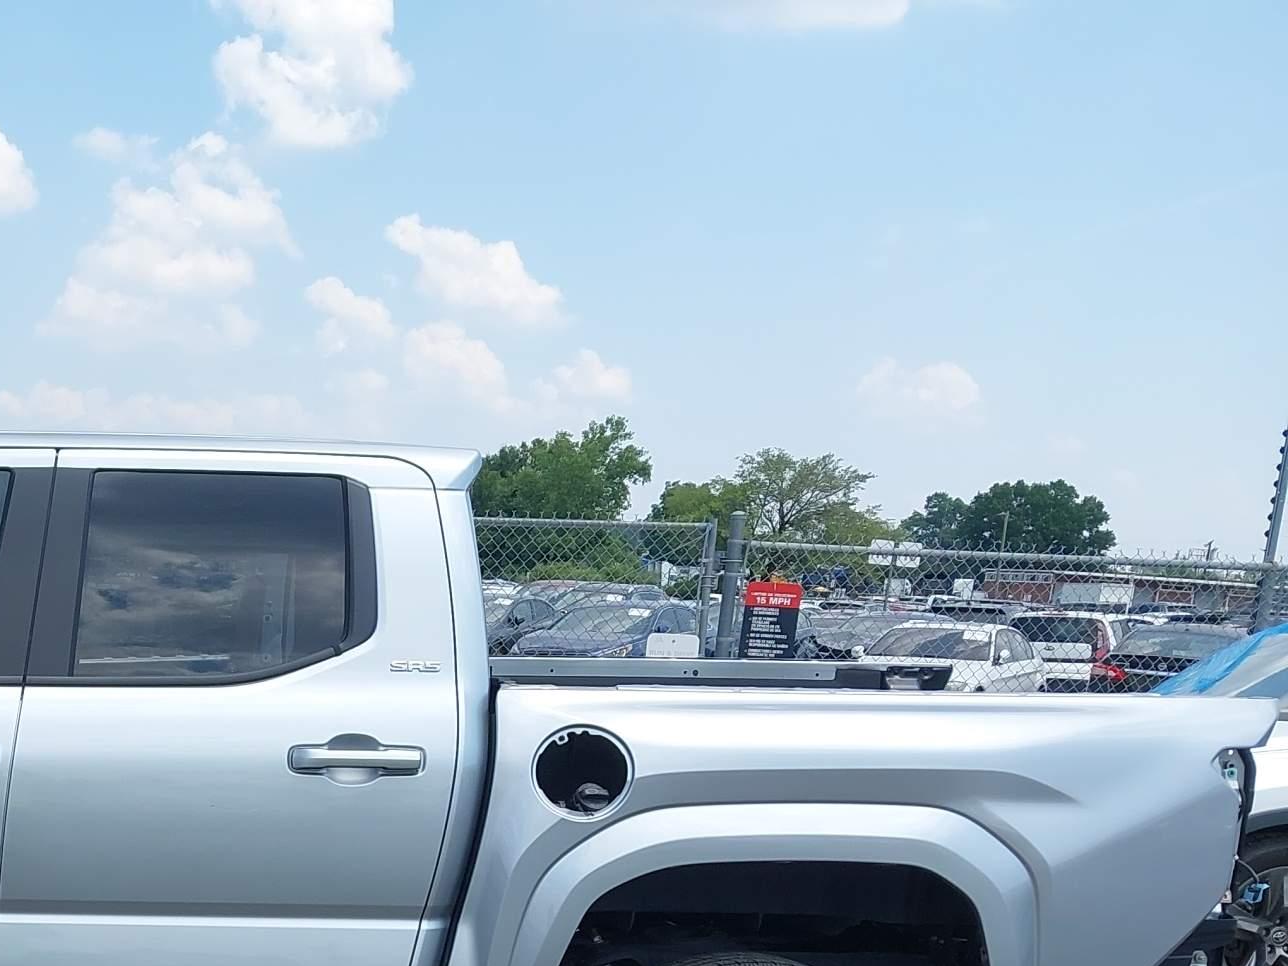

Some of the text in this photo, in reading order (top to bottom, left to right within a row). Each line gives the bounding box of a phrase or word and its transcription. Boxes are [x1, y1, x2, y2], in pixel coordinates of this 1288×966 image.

[756, 597, 791, 606] 15 MPH
[390, 660, 440, 672] SR5
